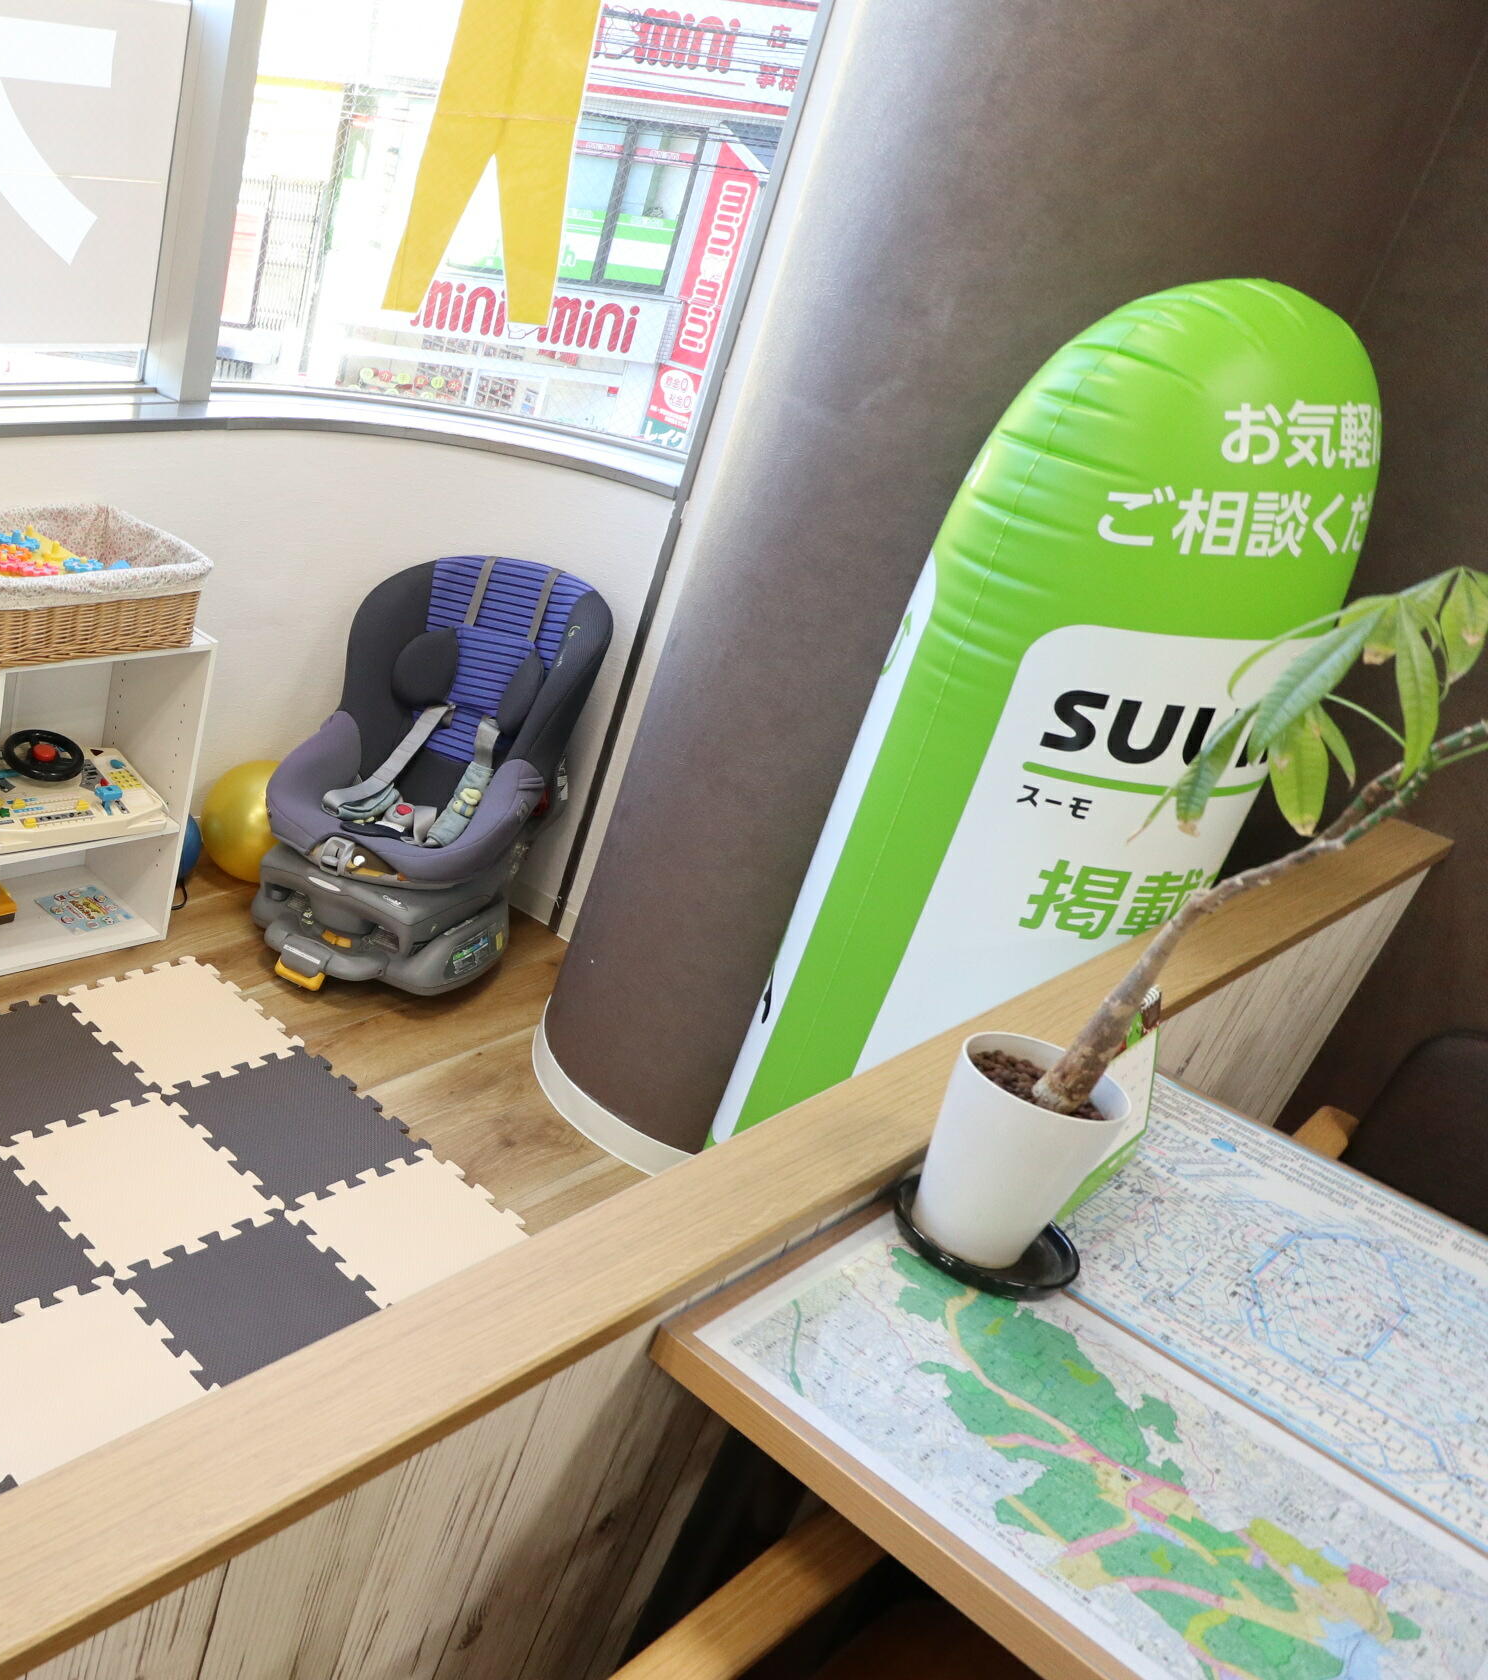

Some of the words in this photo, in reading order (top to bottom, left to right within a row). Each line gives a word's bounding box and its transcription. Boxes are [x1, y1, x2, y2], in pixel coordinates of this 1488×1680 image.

[1017, 783, 1093, 820] スーモ
[1018, 858, 1218, 940] 掲載
